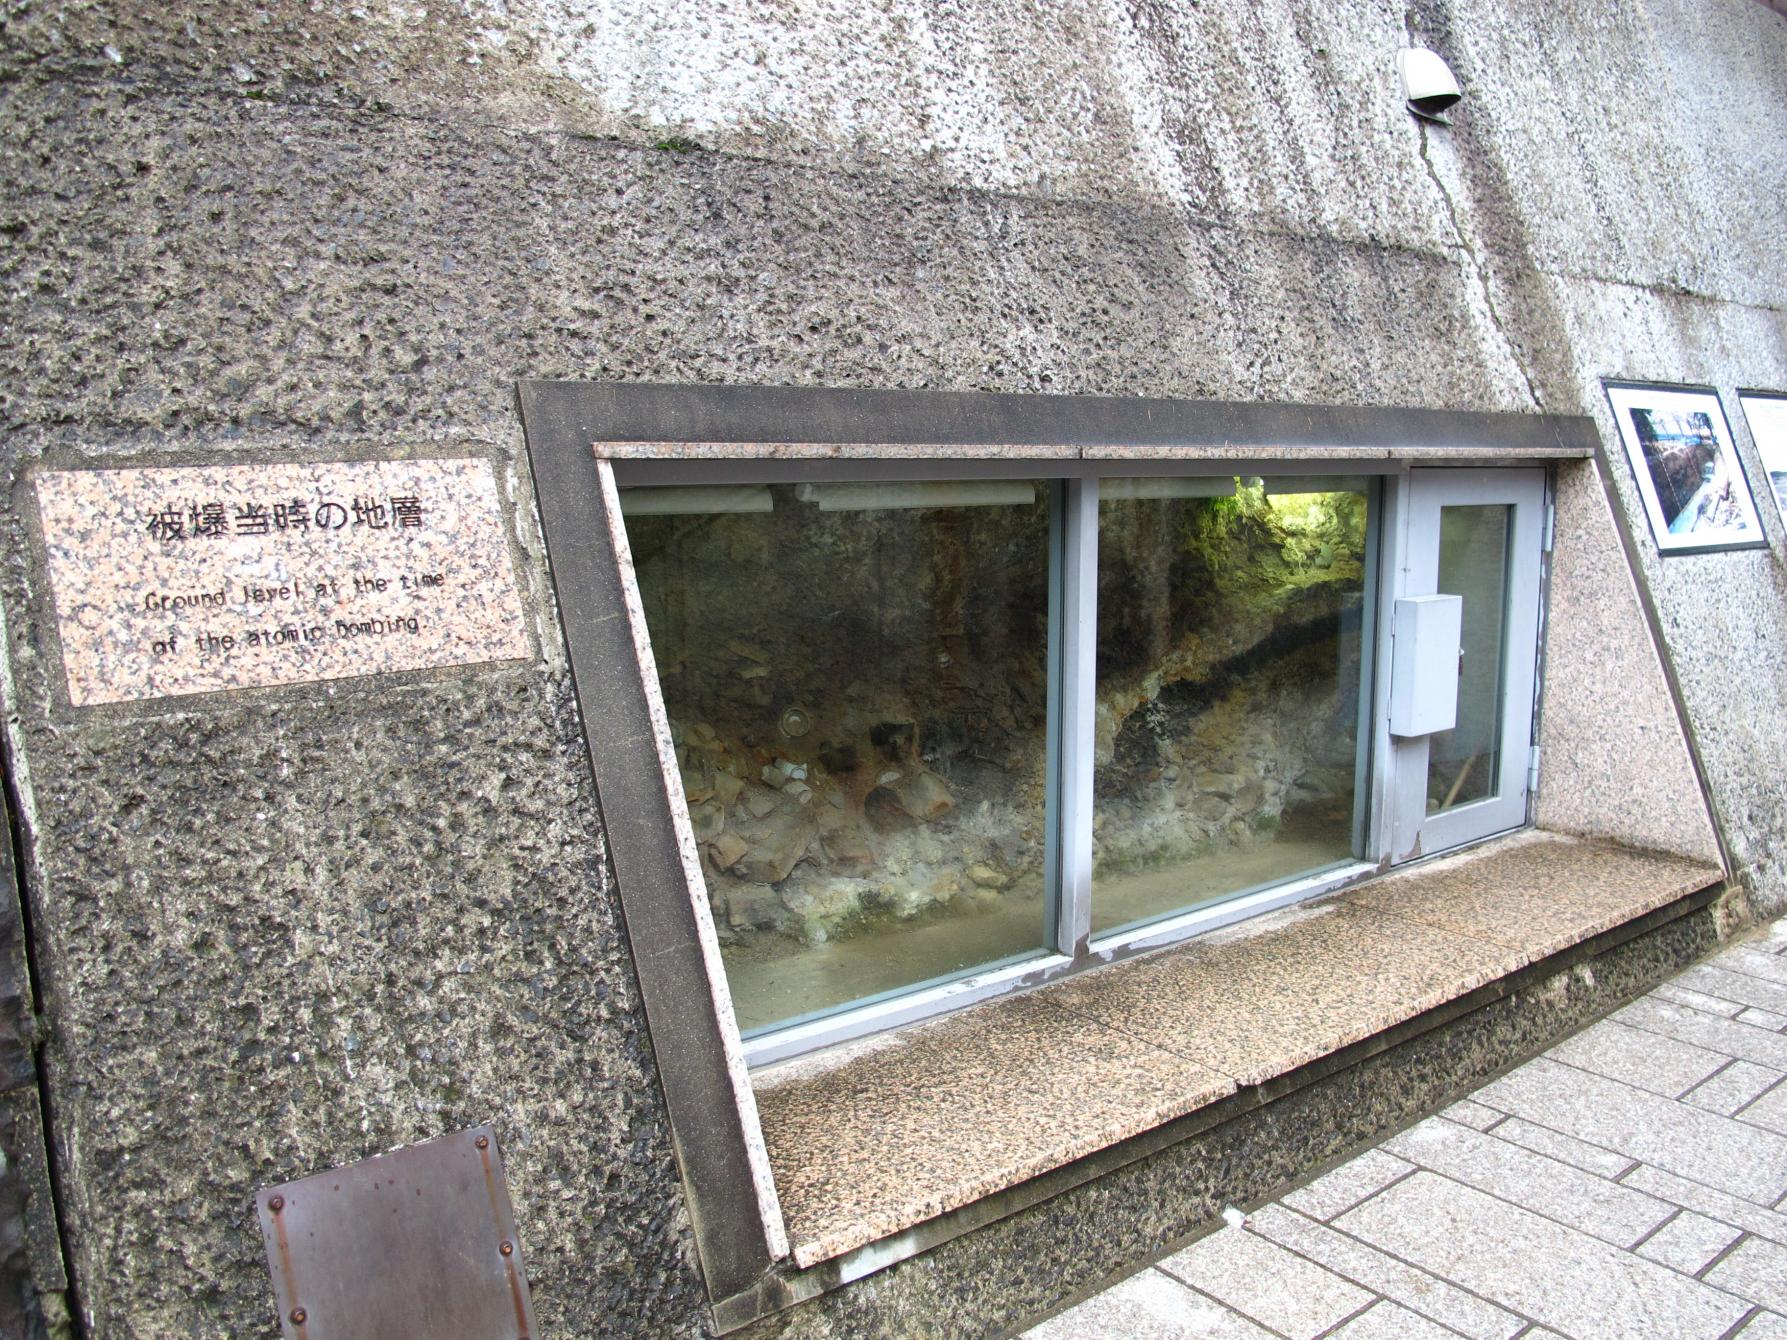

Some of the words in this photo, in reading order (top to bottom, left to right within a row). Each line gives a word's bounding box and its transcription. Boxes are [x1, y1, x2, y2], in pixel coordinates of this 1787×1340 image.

[146, 496, 423, 541] 被爆当時の地層
[145, 587, 226, 612] Ground
[242, 578, 300, 604] level
[315, 579, 338, 597] at
[353, 574, 388, 594] the
[400, 573, 444, 589] time
[152, 634, 177, 656] of
[195, 631, 235, 651] the
[248, 622, 322, 647] atomic
[335, 615, 419, 641] bombing
